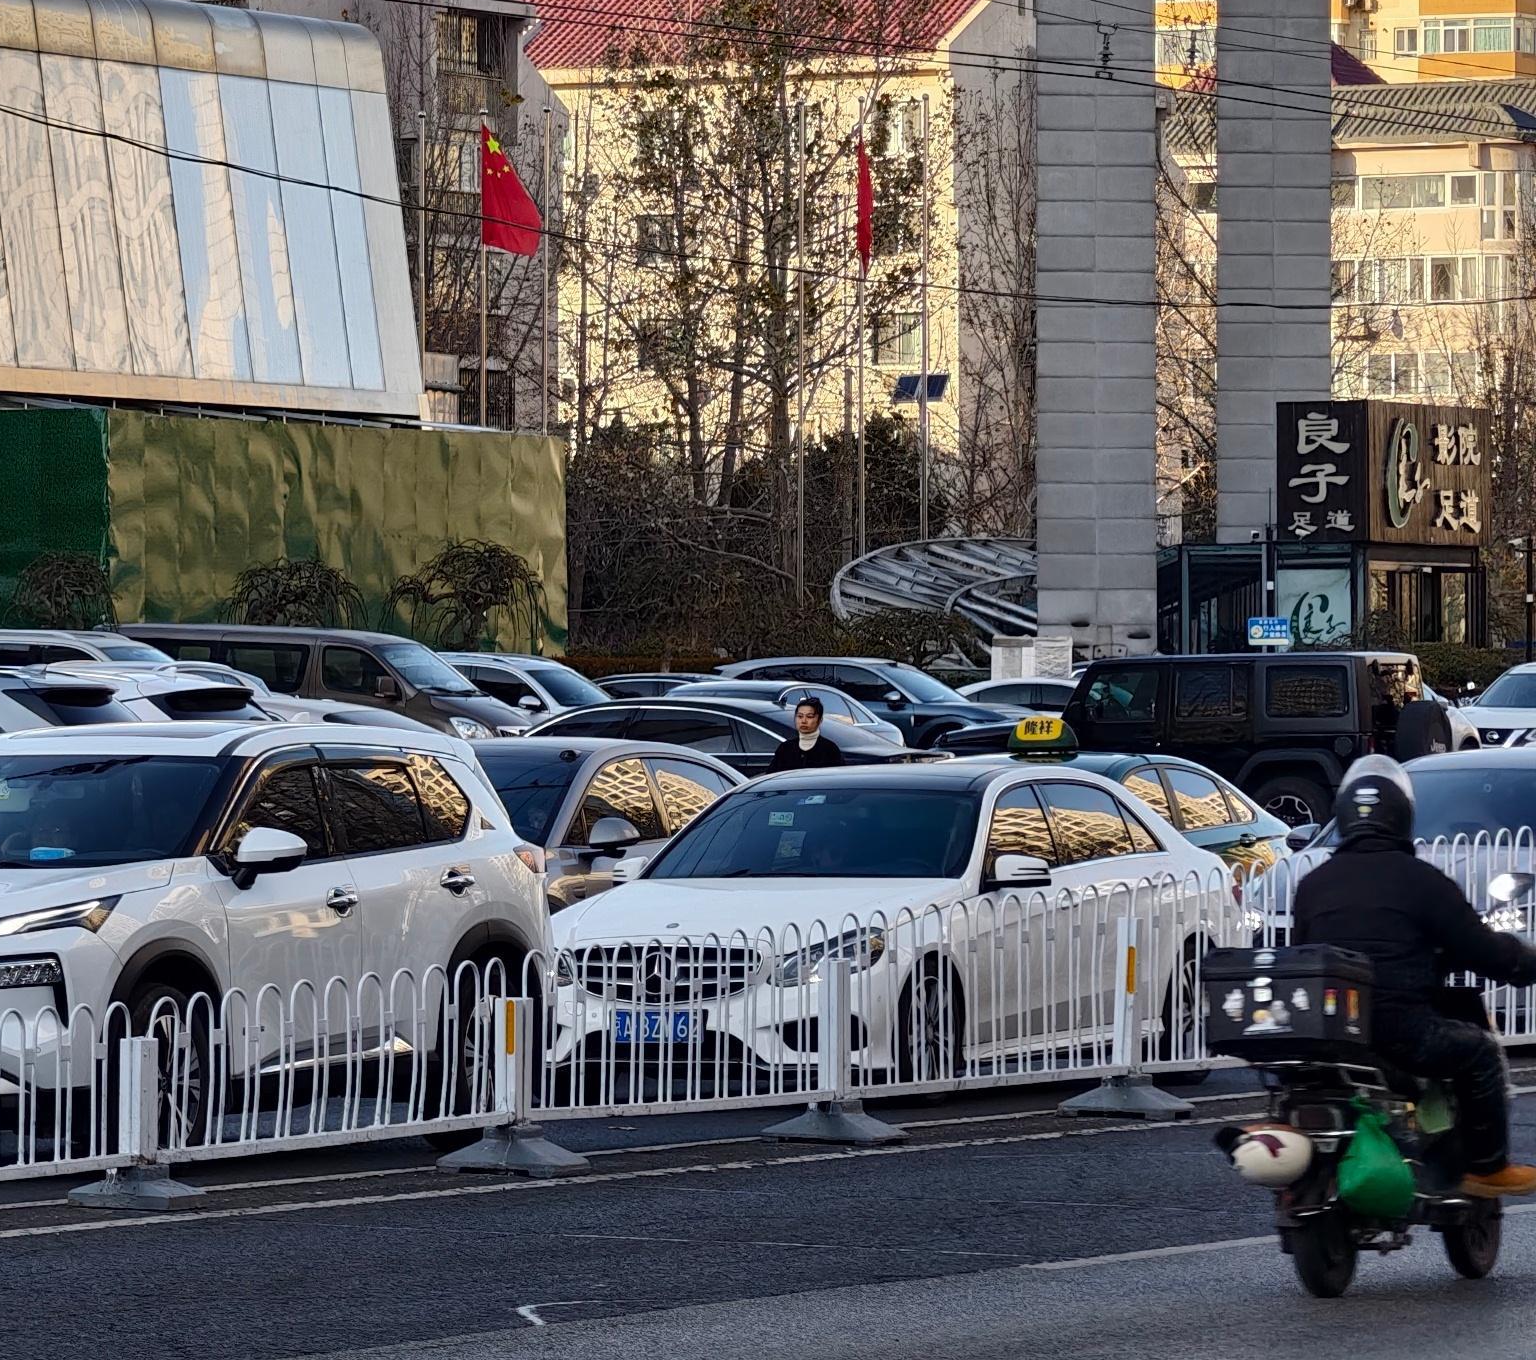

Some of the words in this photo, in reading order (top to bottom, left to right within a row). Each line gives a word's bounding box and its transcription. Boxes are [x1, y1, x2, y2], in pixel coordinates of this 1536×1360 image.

[1288, 411, 1351, 504] 良子
[1434, 423, 1481, 466] 影院
[1287, 509, 1355, 532] 足道
[1436, 489, 1482, 534] 足道
